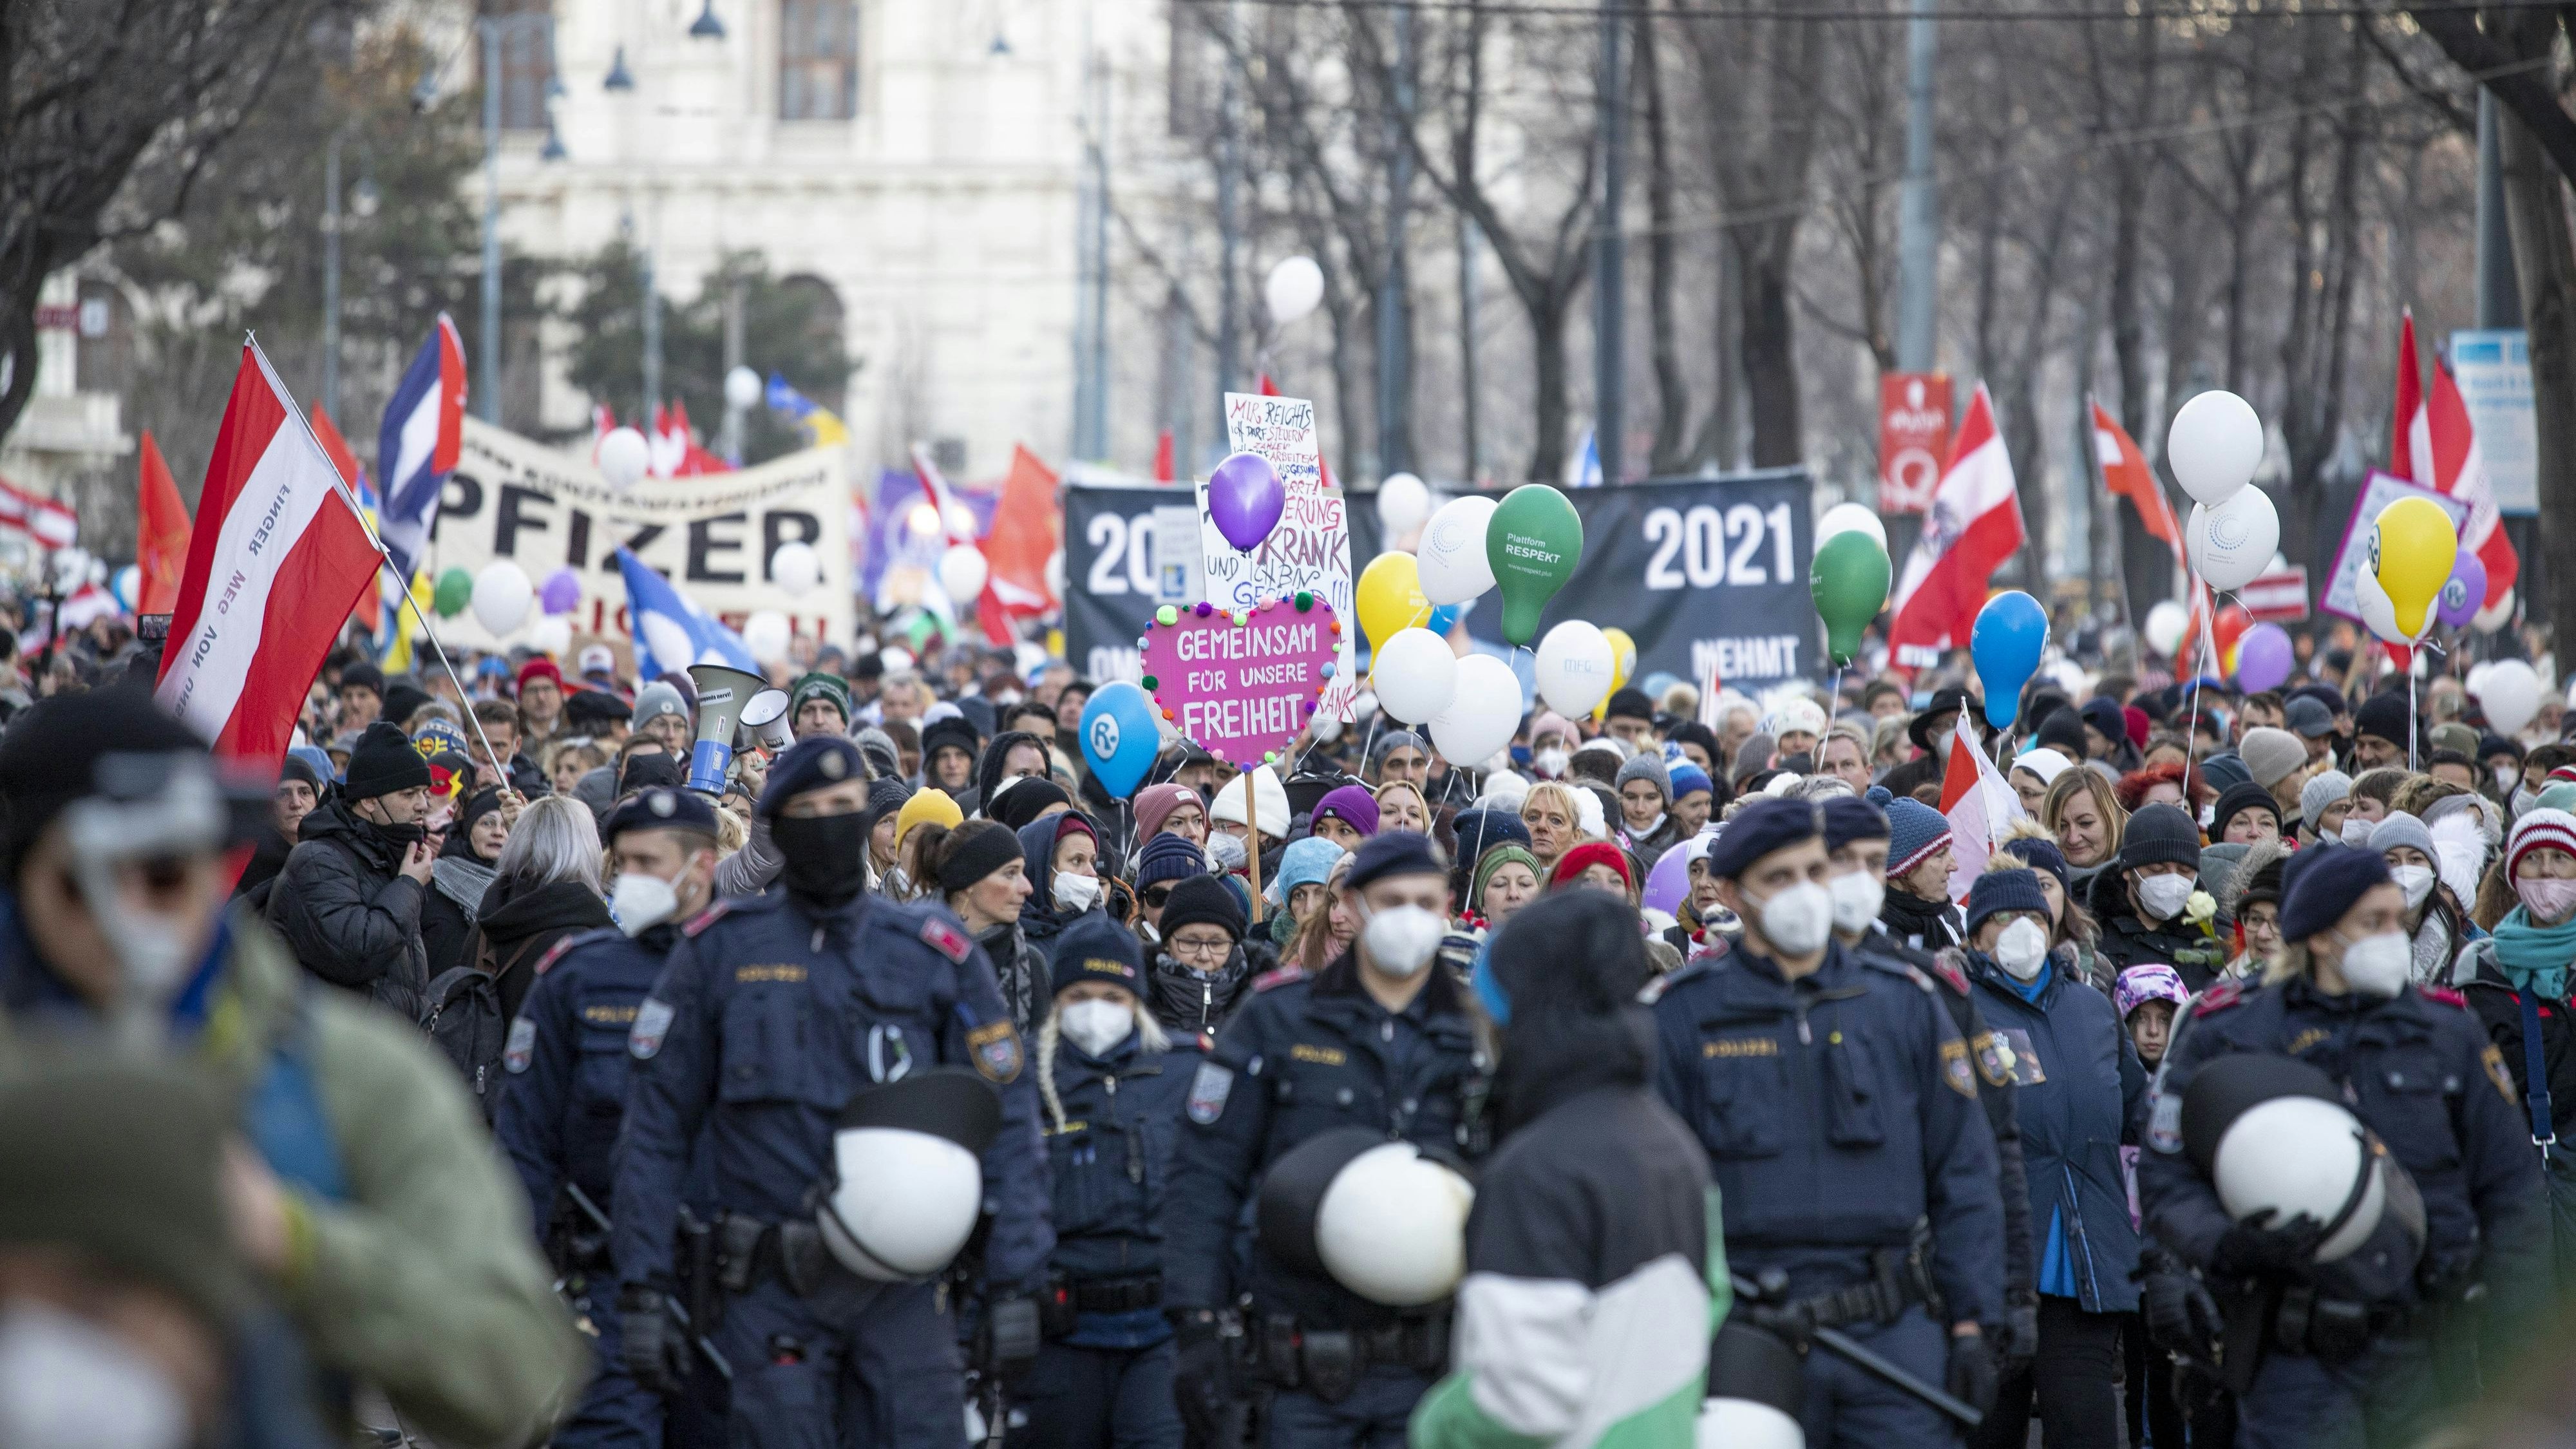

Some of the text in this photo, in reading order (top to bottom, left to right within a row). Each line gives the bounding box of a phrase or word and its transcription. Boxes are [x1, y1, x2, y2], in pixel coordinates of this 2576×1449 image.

[1230, 399, 1262, 424] MIR
[1247, 426, 1267, 440] DARF
[1267, 426, 1309, 442] STEUERN
[430, 472, 825, 583] PFIZER
[1508, 533, 1546, 547] Plattform
[1257, 526, 1349, 578] KRANK
[1506, 544, 1561, 564] RESPEKT
[1644, 502, 1795, 590] 2021
[1208, 555, 1238, 582] UND
[1250, 558, 1276, 585] ICH
[1177, 623, 1316, 661] GEMEINSAM
[1692, 634, 1800, 681] NEHMT
[1188, 662, 1308, 692] FÜR UNSERE
[1183, 694, 1303, 742] FREIHEIT
[1702, 1037, 1778, 1059] POLIZEI
